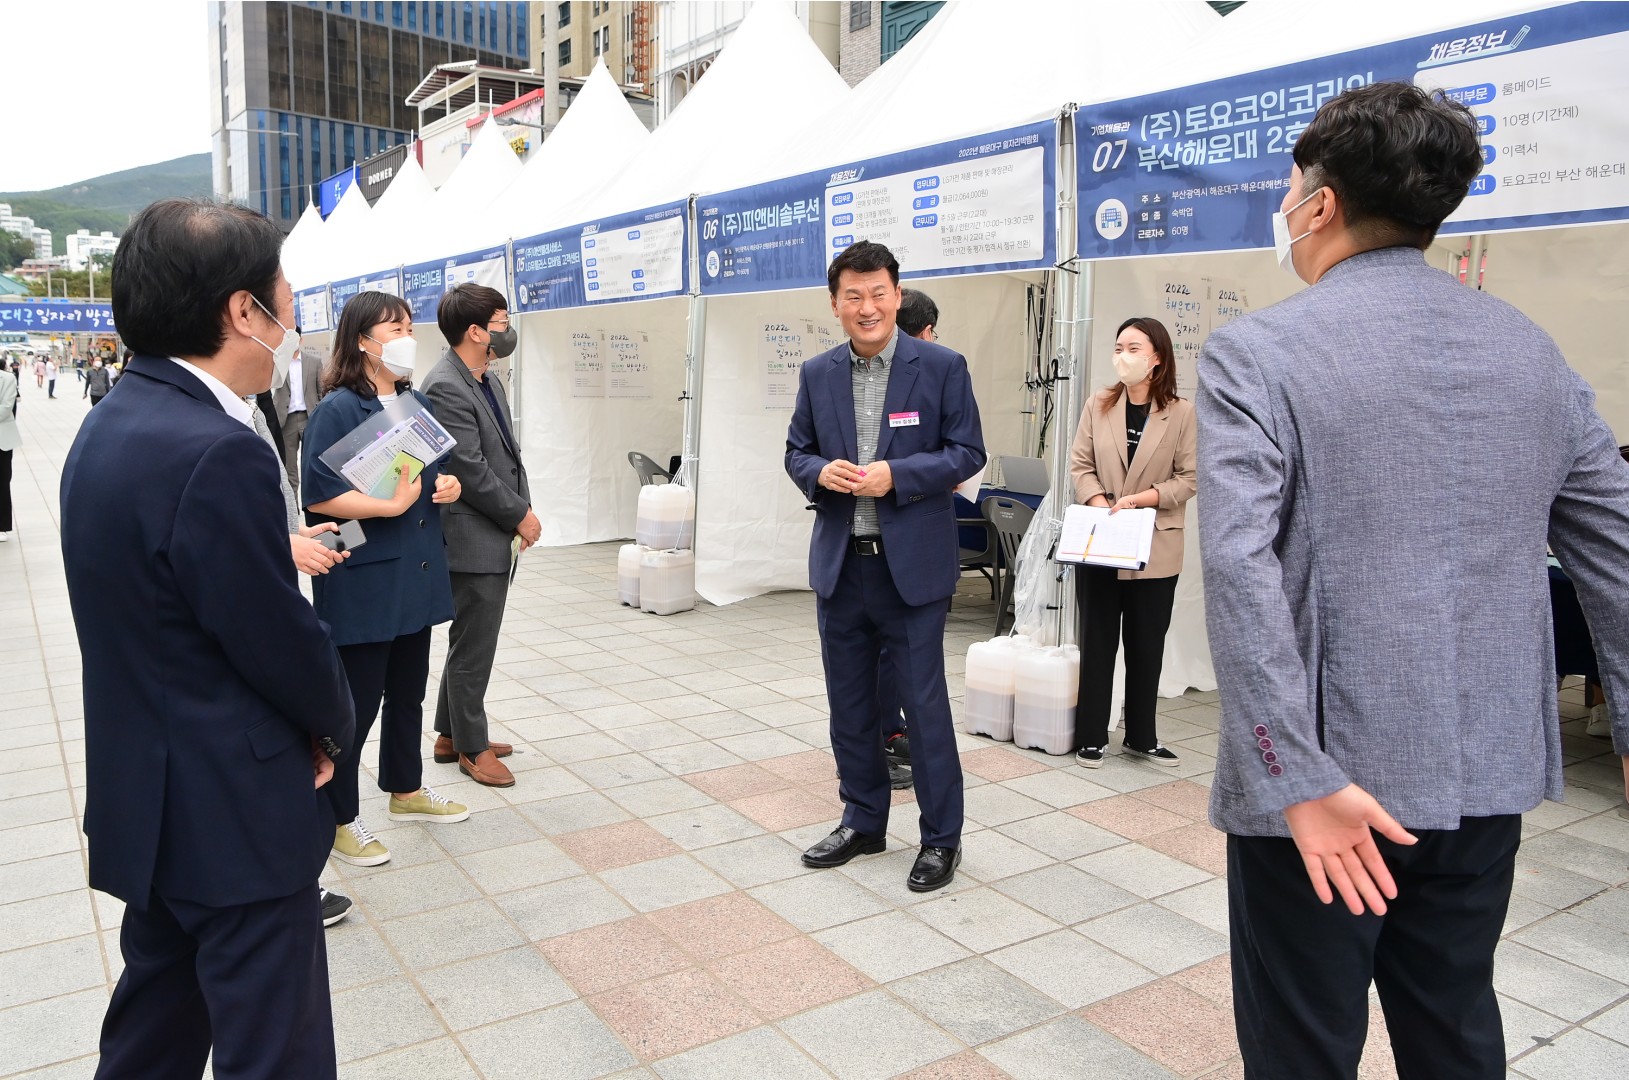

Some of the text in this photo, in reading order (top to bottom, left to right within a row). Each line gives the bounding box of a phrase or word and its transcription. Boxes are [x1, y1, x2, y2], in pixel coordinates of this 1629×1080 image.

[1428, 30, 1508, 61] 채용정보
[1501, 76, 1552, 96] 룸메이드
[1502, 105, 1579, 128] 10명(기간제)
[1091, 121, 1131, 136] 기업채용관
[958, 146, 980, 158] 2022년
[1092, 139, 1128, 172] 07
[1138, 130, 1258, 172] 부산해운대
[1502, 142, 1538, 158] 이력서
[1502, 163, 1626, 188] 토요코인 부산 해운대
[1171, 188, 1208, 200] 부산광역시
[1209, 182, 1240, 195] 해운대구
[722, 197, 820, 237] (주)피앤비솔루션
[1171, 207, 1193, 217] 숙박업
[703, 219, 719, 240] 06
[1138, 229, 1165, 239] 근로자수
[1171, 226, 1189, 236] 60명
[516, 257, 526, 272] 05
[36, 308, 82, 325] 일자리
[1165, 297, 1201, 319] 해운대구
[1174, 321, 1200, 337] 일자리
